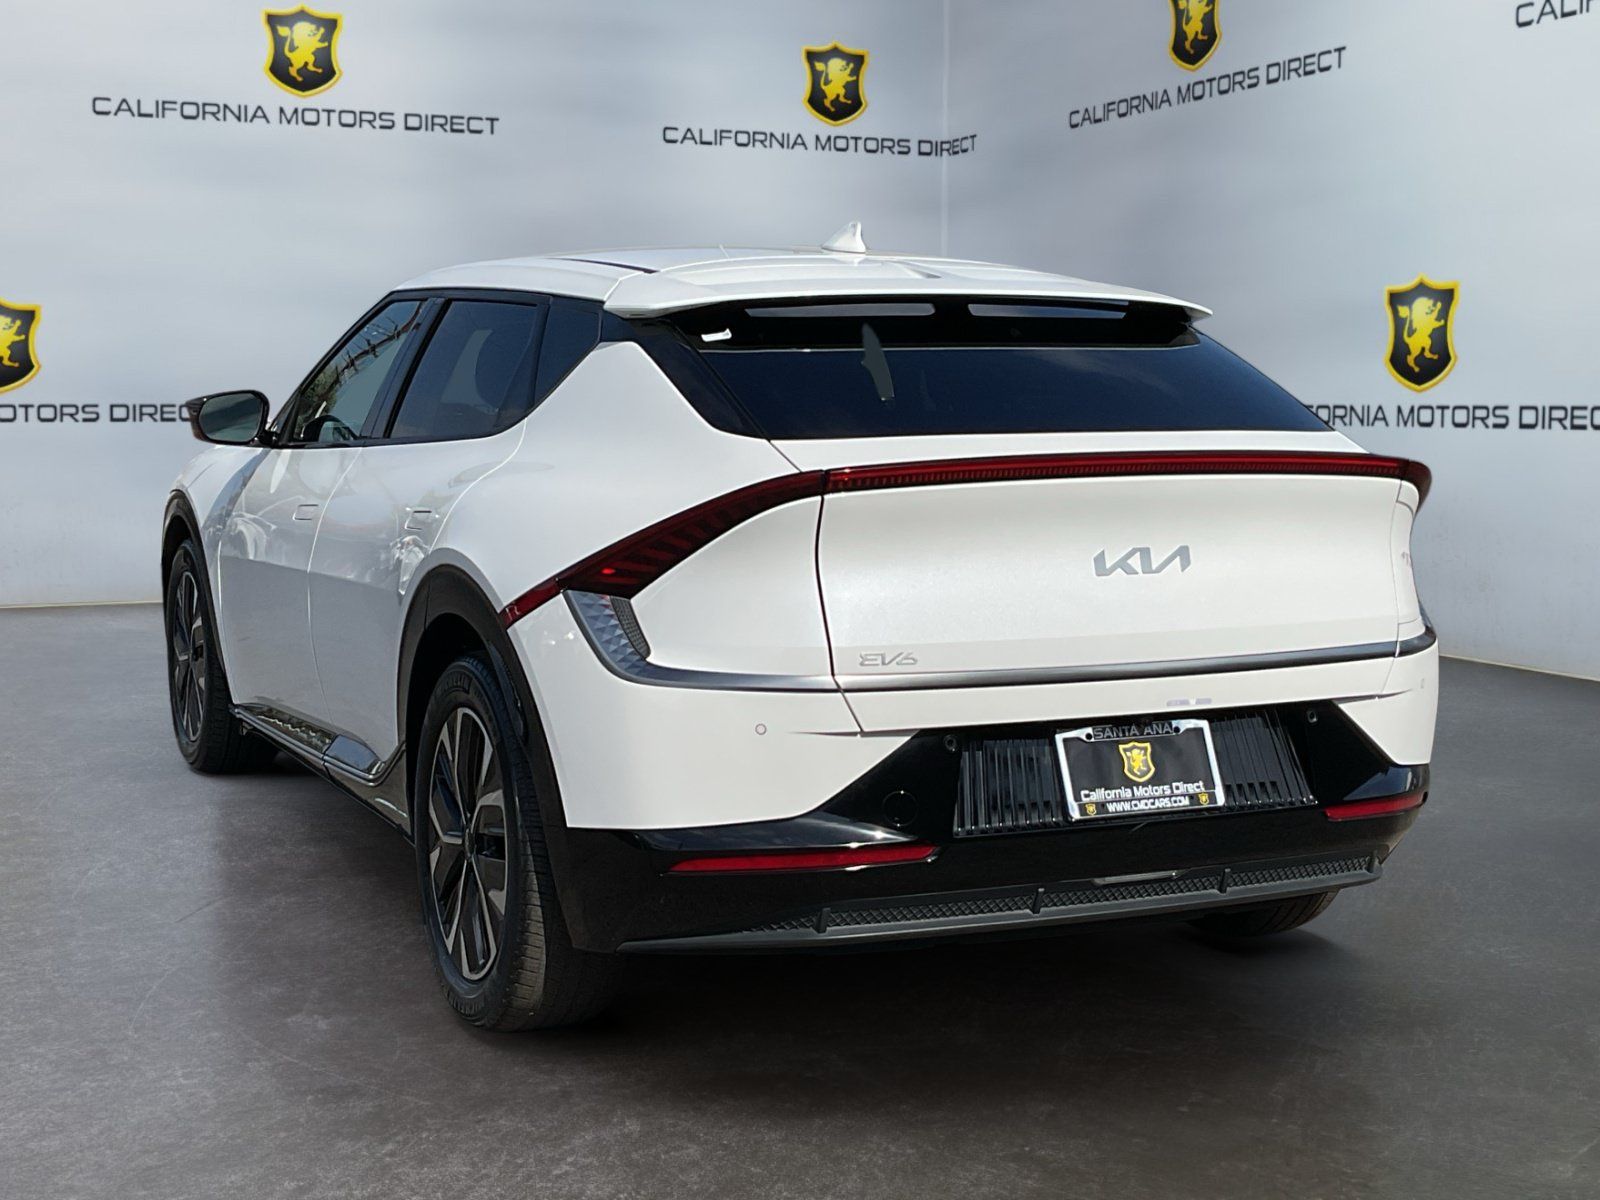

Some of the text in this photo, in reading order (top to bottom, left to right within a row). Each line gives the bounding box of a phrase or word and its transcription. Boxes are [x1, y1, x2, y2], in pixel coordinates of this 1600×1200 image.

[1069, 46, 1347, 129] CALIFORNIA MOTORS DIRECT
[92, 97, 500, 135] CALIFORNIA MOTORS DIRECT
[662, 126, 977, 157] CALIFORNIA MOTORS DIRECT
[1396, 405, 1509, 429] MOTORS
[1093, 545, 1191, 577] KIA
[859, 651, 918, 667] EV6
[1093, 721, 1174, 739] SANTA ANA
[1080, 780, 1205, 802] California Motors Direct
[1106, 796, 1190, 813] WWW.CMDCARS.COM
